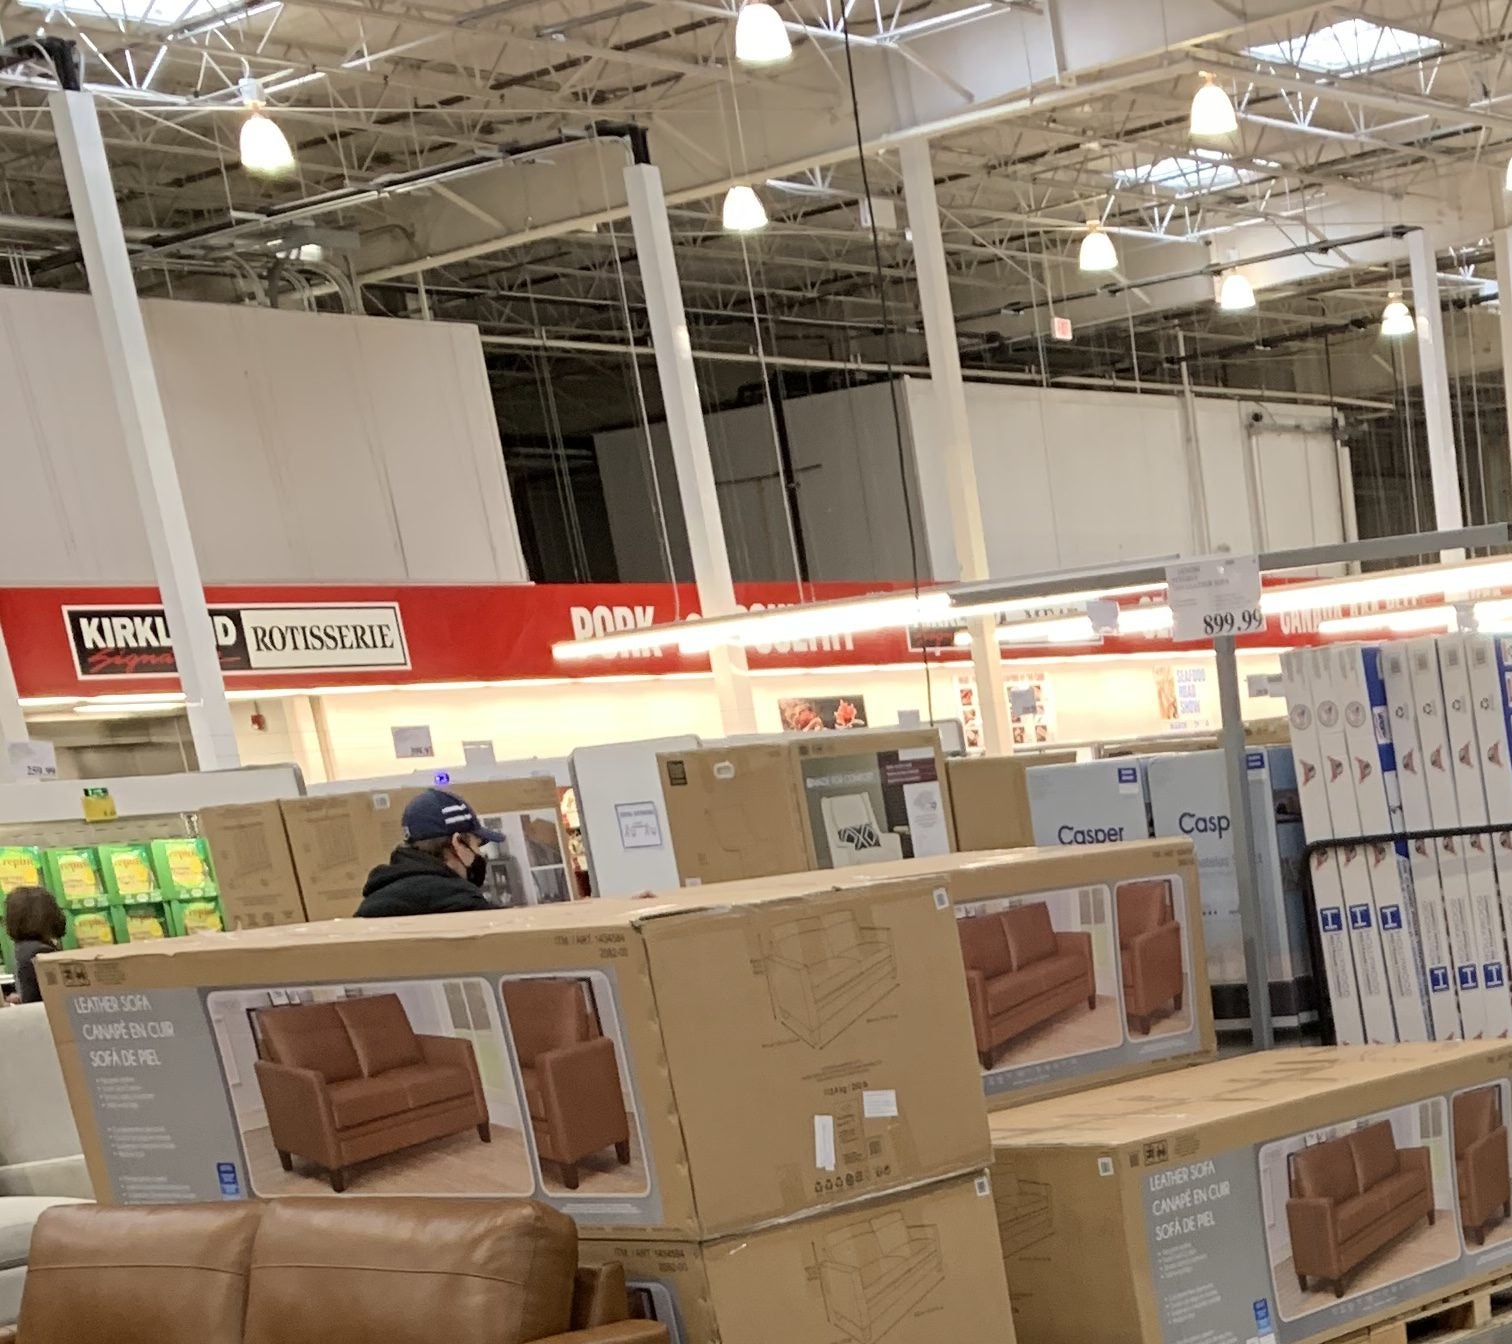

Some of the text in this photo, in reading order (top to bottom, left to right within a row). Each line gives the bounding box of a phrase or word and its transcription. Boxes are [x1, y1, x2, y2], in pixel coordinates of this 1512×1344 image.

[79, 614, 238, 649] KIRKLD
[1203, 608, 1264, 636] 899.99
[250, 622, 395, 652] ROTISSERIE
[1057, 825, 1125, 846] Casper
[1178, 811, 1231, 839] Casp
[74, 994, 152, 1014] LEATHER SOFA
[128, 1022, 147, 1039] EN
[147, 1021, 175, 1038] CUIR
[121, 1049, 138, 1066] DE
[138, 1048, 162, 1065] PIEL
[1149, 1160, 1216, 1191] LEATHER SOFA
[1193, 1187, 1208, 1204] EN
[1208, 1180, 1231, 1200] CUIR
[1182, 1215, 1196, 1233] DE
[1197, 1210, 1216, 1227] PIEL
